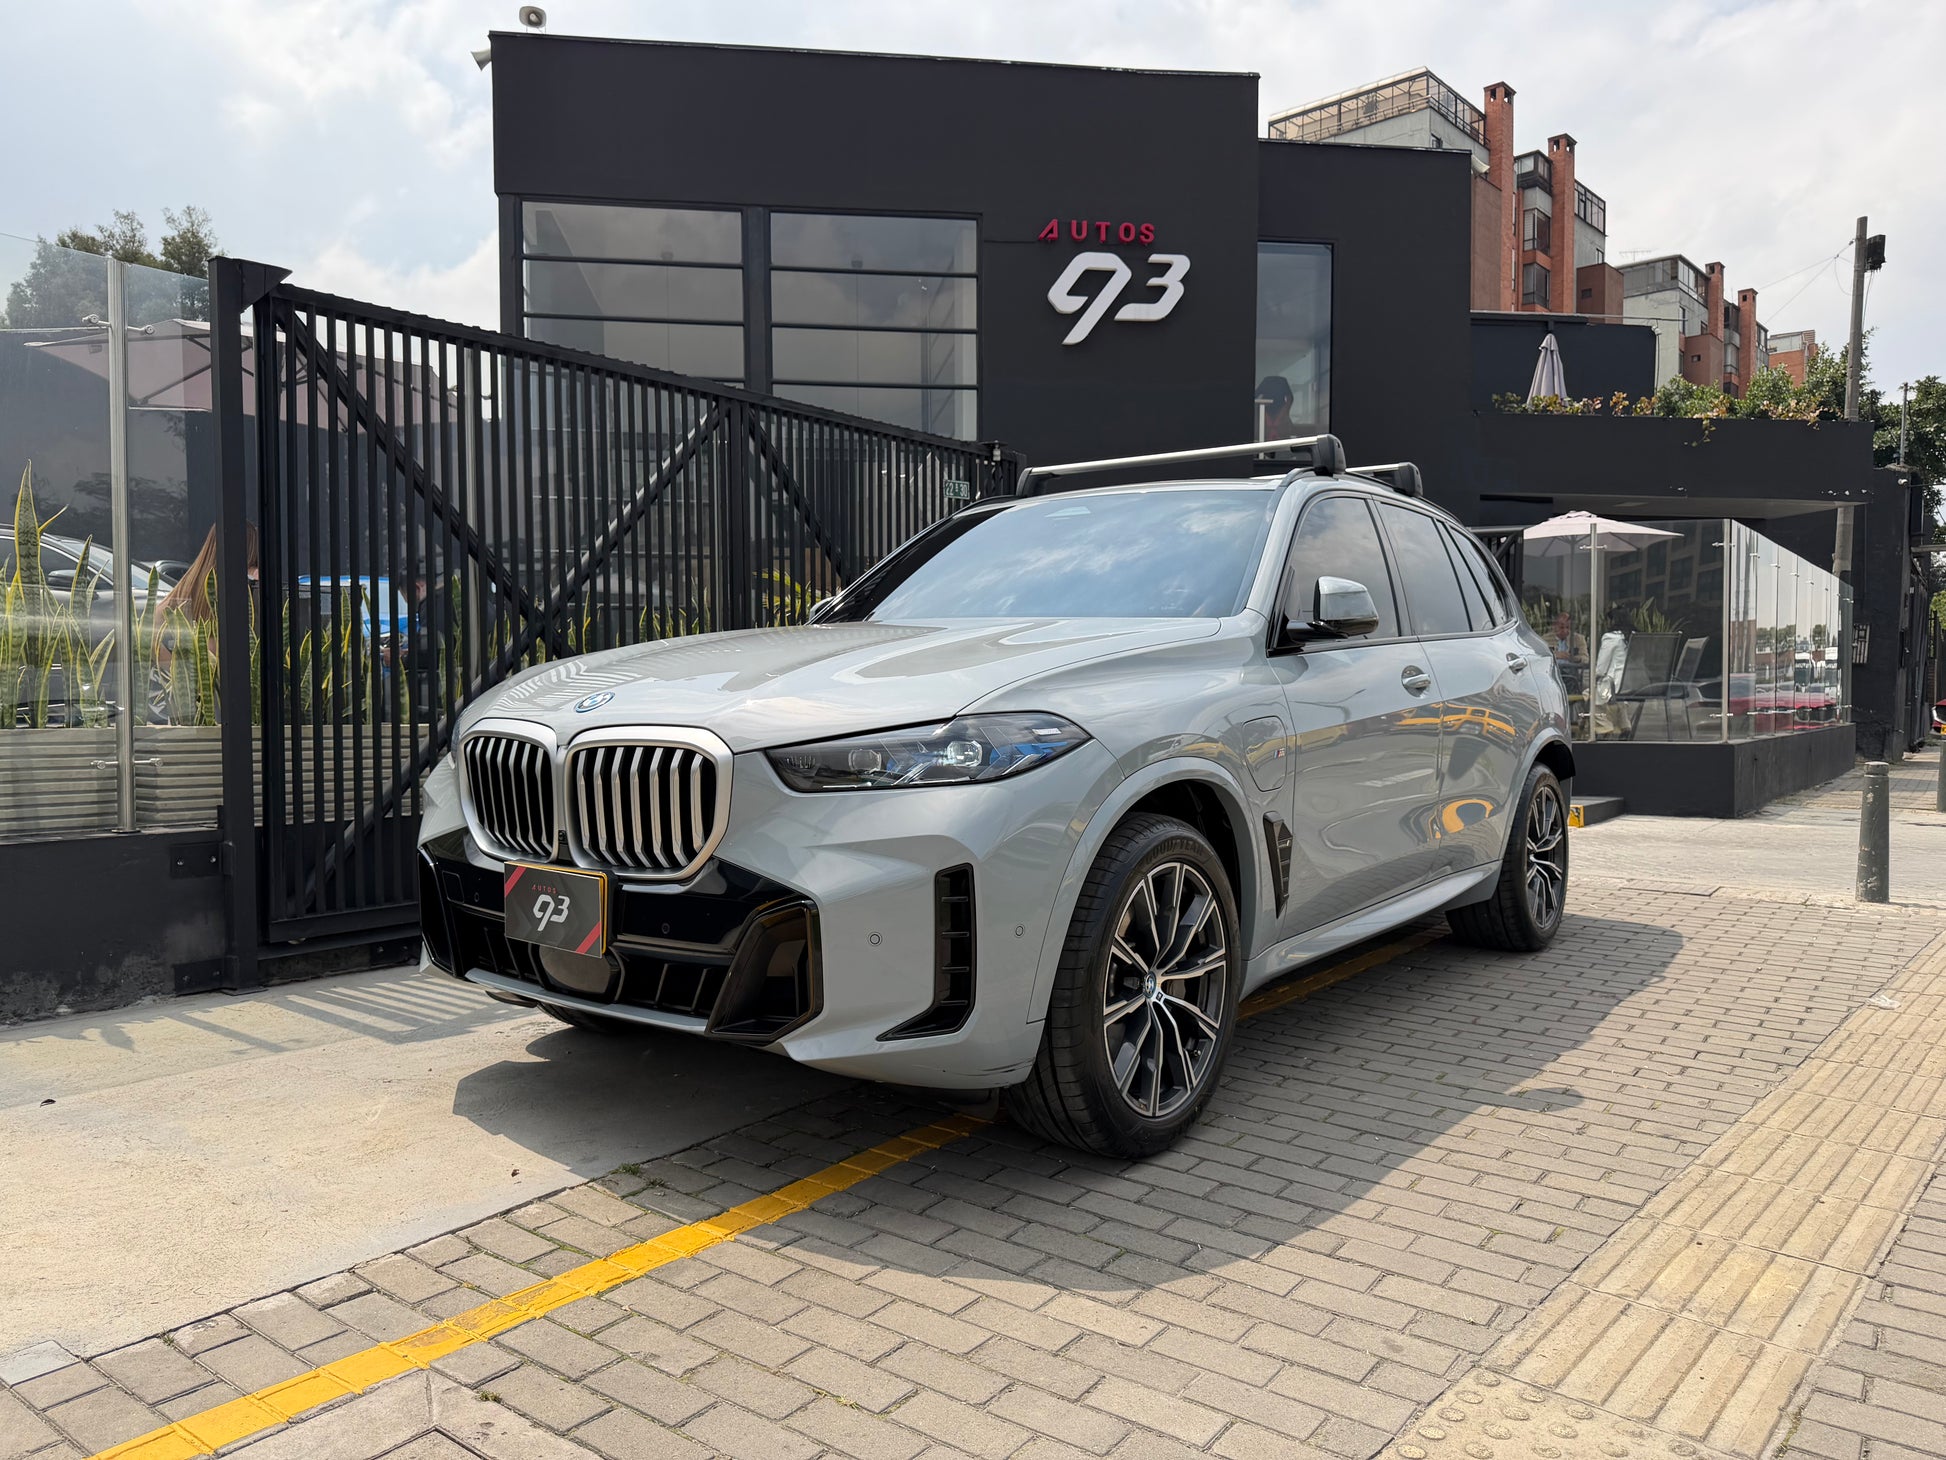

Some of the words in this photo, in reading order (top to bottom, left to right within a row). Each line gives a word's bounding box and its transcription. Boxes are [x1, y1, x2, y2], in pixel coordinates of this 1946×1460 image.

[1038, 218, 1155, 244] AUTOS
[1047, 251, 1191, 346] 93
[531, 884, 557, 894] AUTOS
[533, 894, 570, 931] 93
